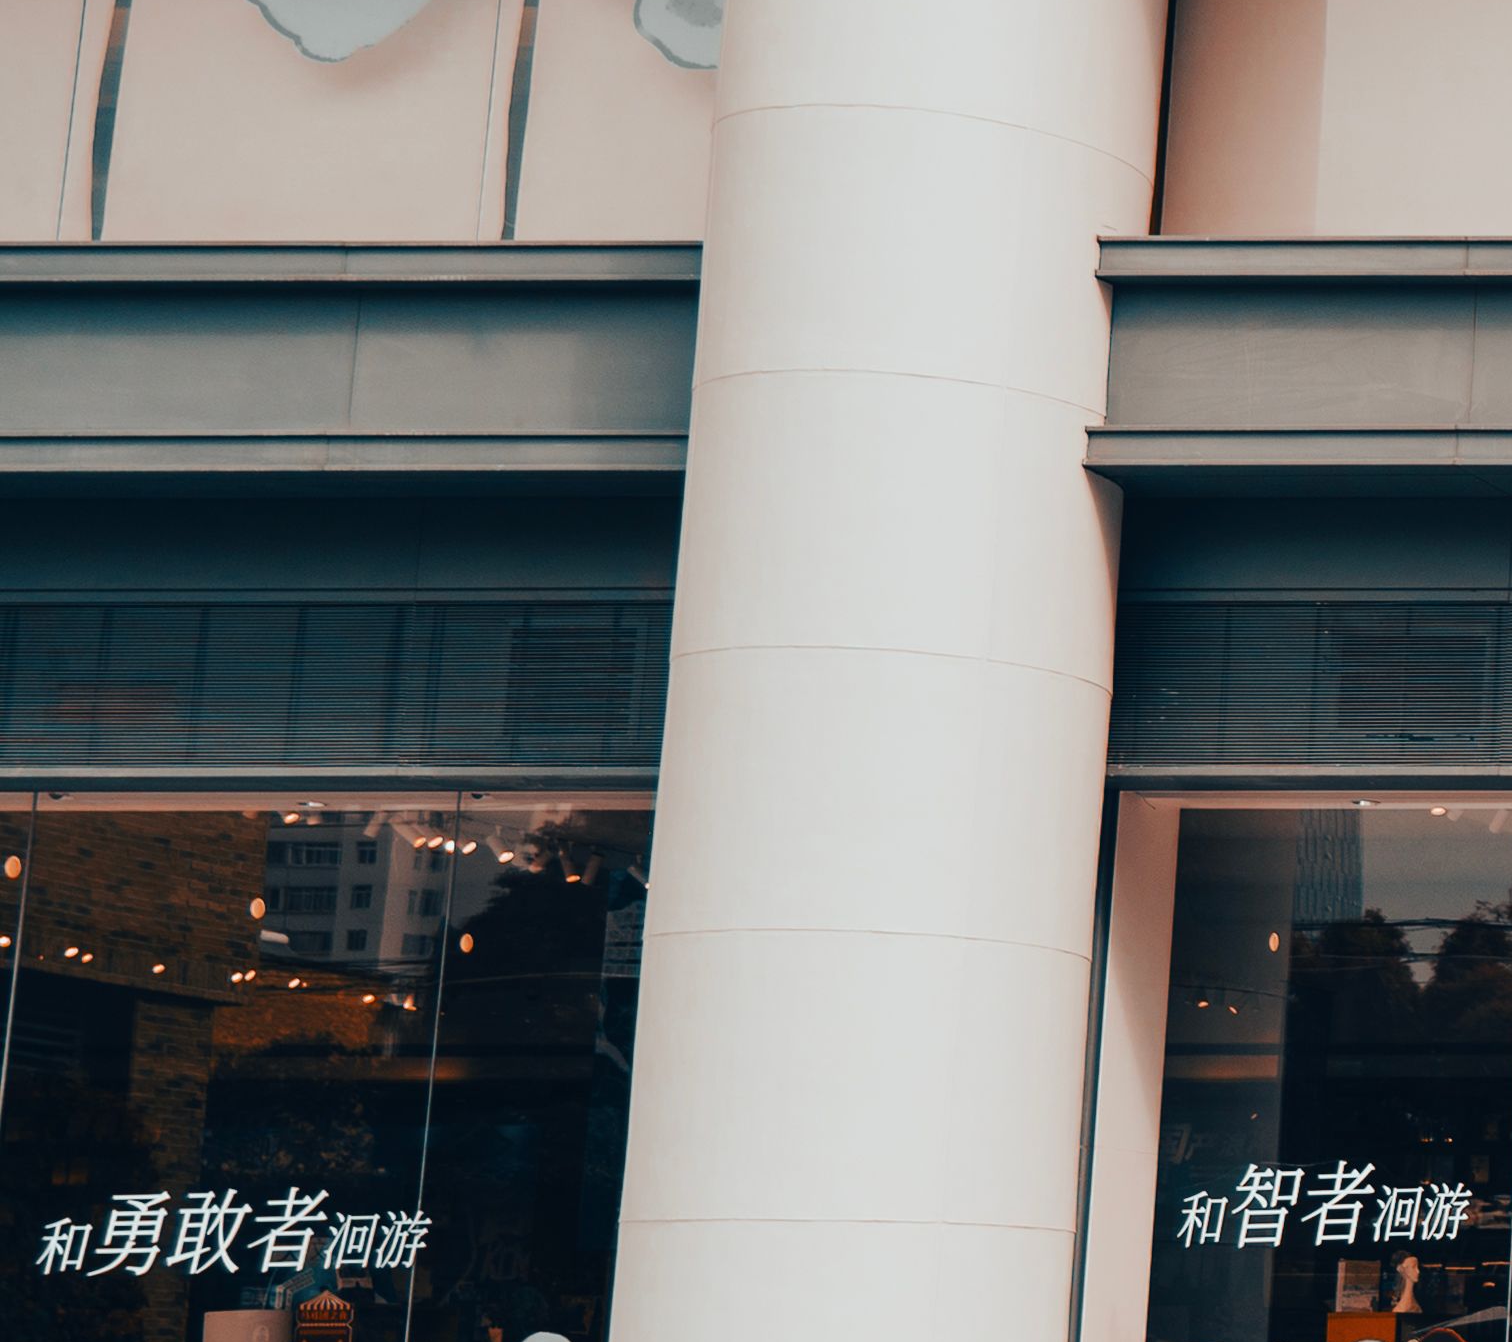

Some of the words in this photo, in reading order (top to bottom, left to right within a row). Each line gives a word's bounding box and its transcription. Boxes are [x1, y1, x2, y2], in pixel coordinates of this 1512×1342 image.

[35, 1186, 433, 1277] 和勇敢者洄游
[1176, 1160, 1473, 1248] 和智者洄游
